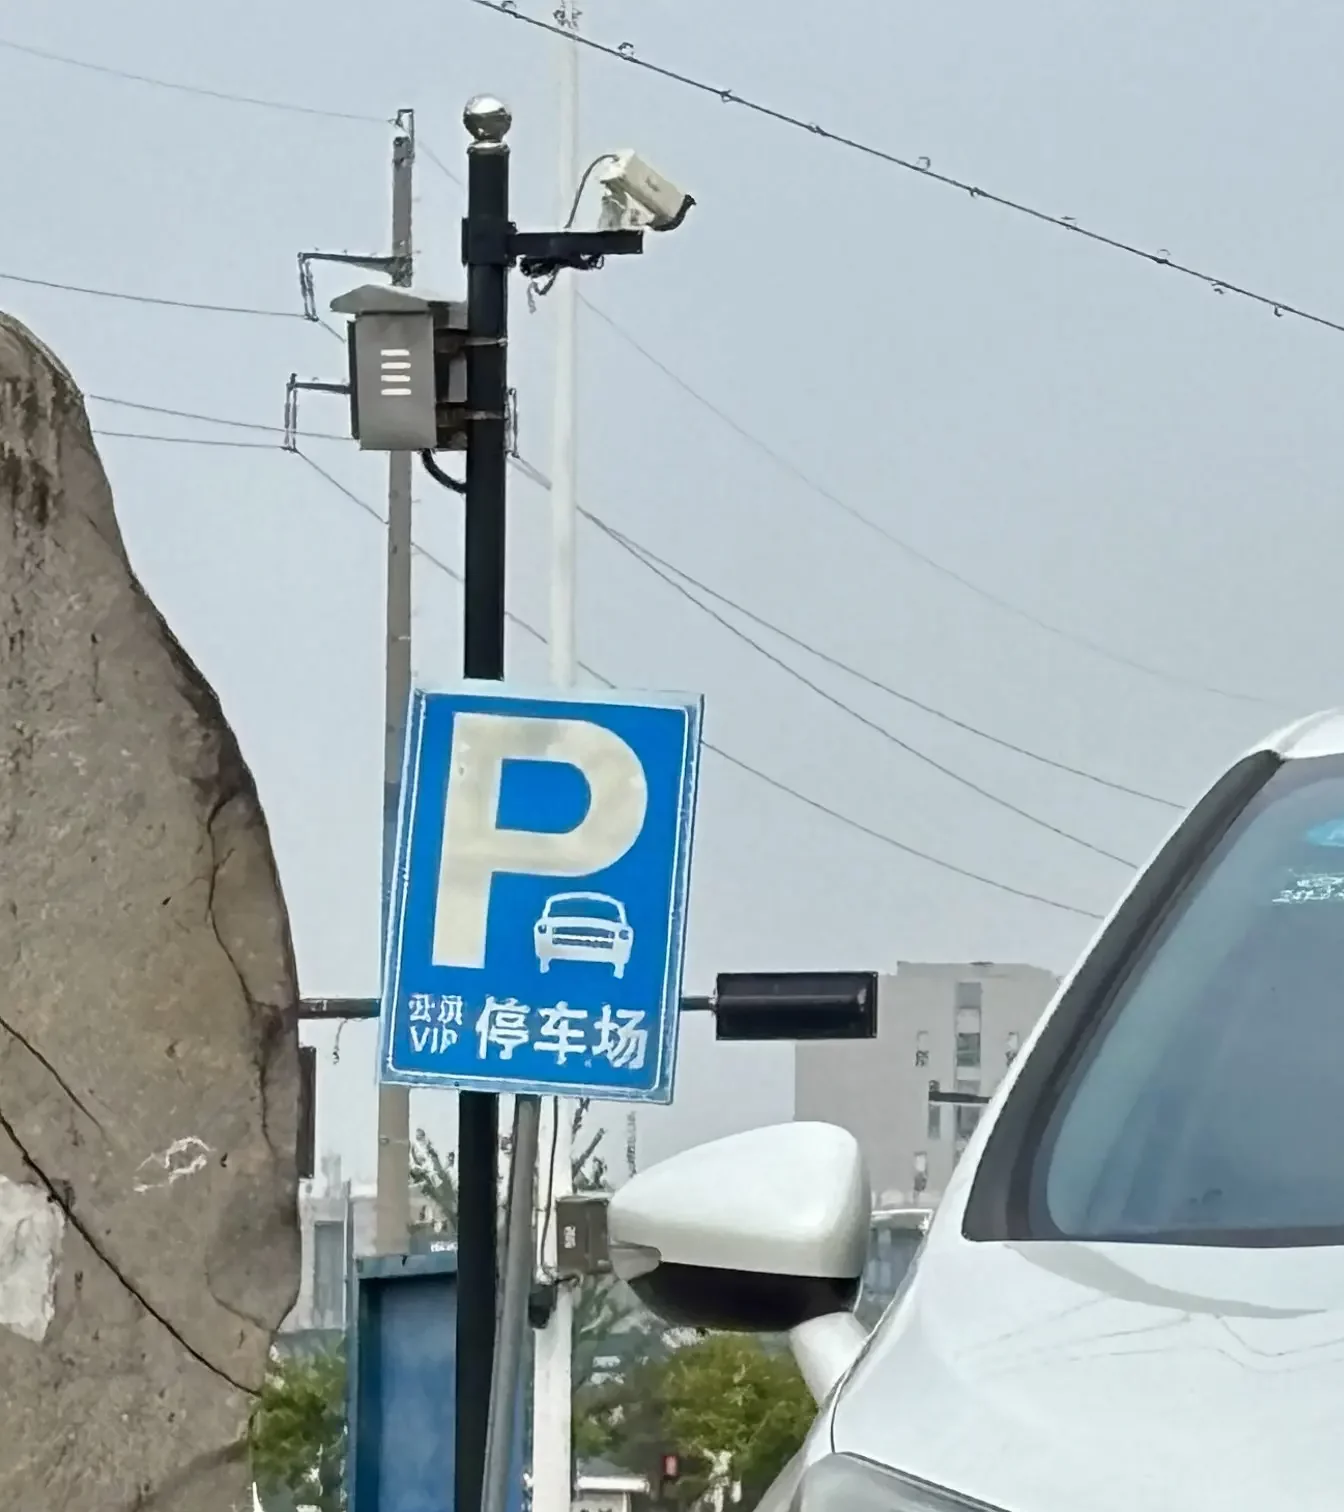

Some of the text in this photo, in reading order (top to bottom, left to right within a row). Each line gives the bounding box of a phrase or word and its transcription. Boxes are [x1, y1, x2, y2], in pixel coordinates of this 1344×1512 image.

[432, 711, 648, 969] P
[409, 1025, 458, 1055] VIP
[475, 993, 648, 1070] 停车场
